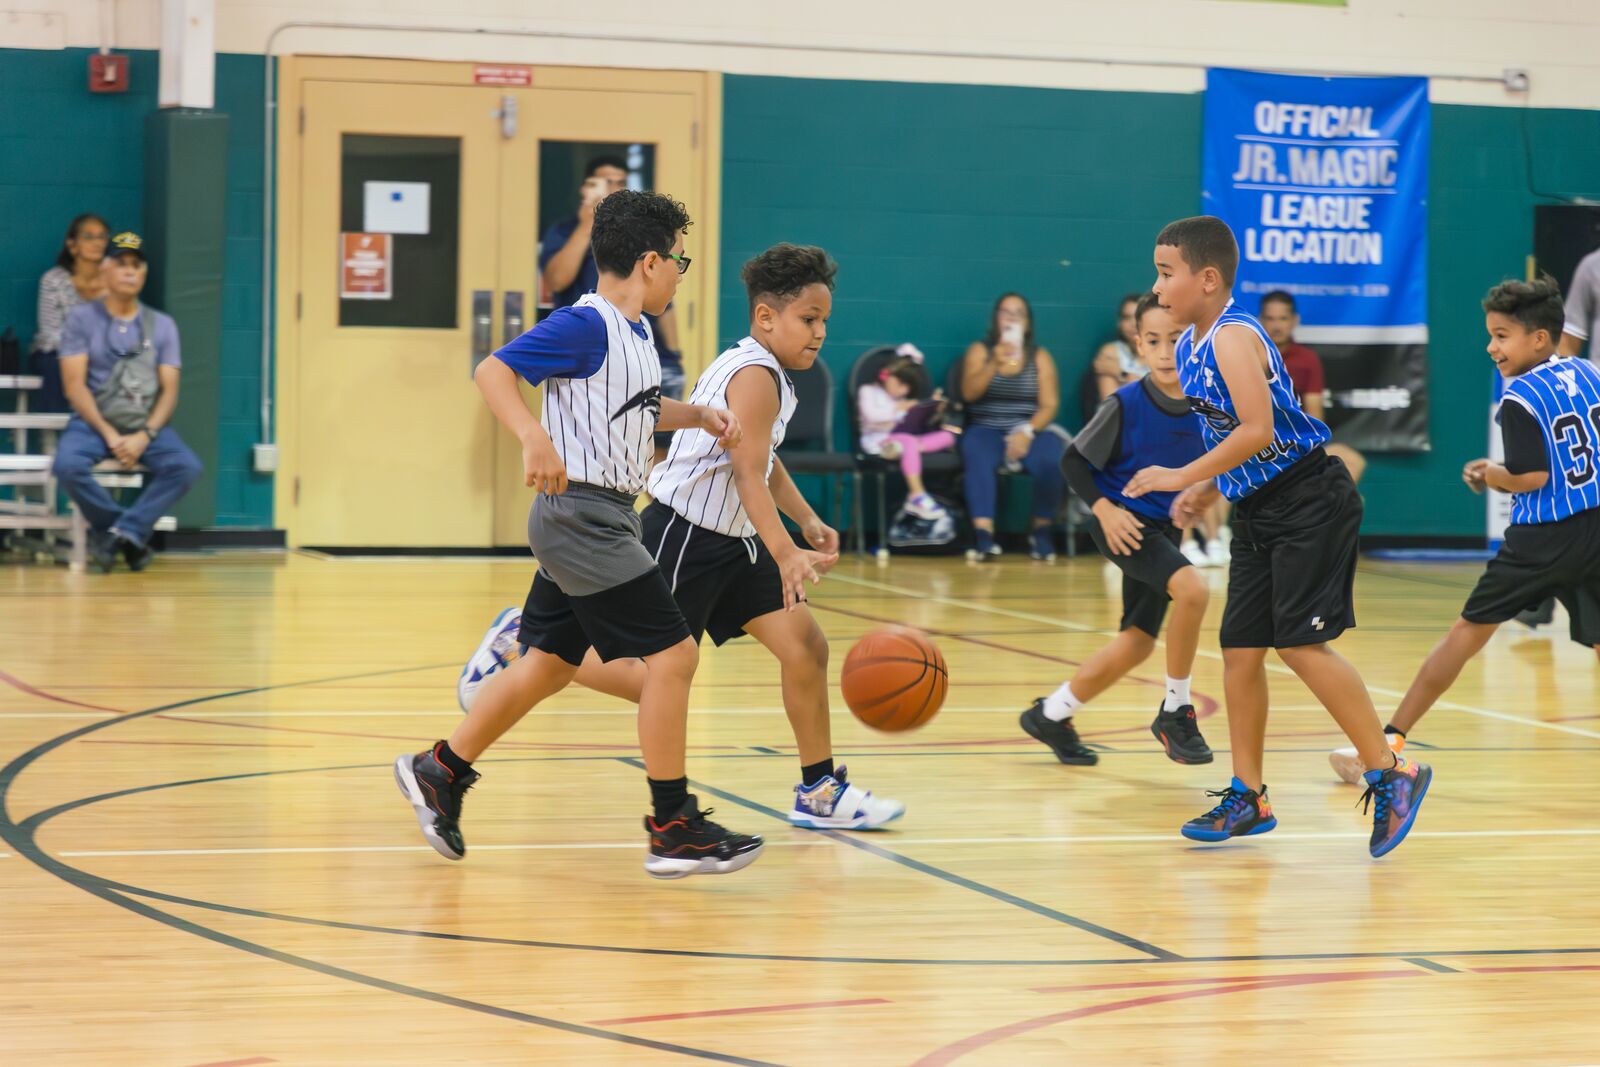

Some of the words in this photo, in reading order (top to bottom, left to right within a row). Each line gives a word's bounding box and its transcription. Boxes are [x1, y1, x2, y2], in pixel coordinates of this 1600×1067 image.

[1255, 101, 1380, 138] OFFICIAL
[1232, 143, 1287, 183] JR.
[1288, 146, 1398, 187] MAGIC
[1261, 194, 1373, 229] LEAGUE
[1245, 228, 1382, 264] LOCATION
